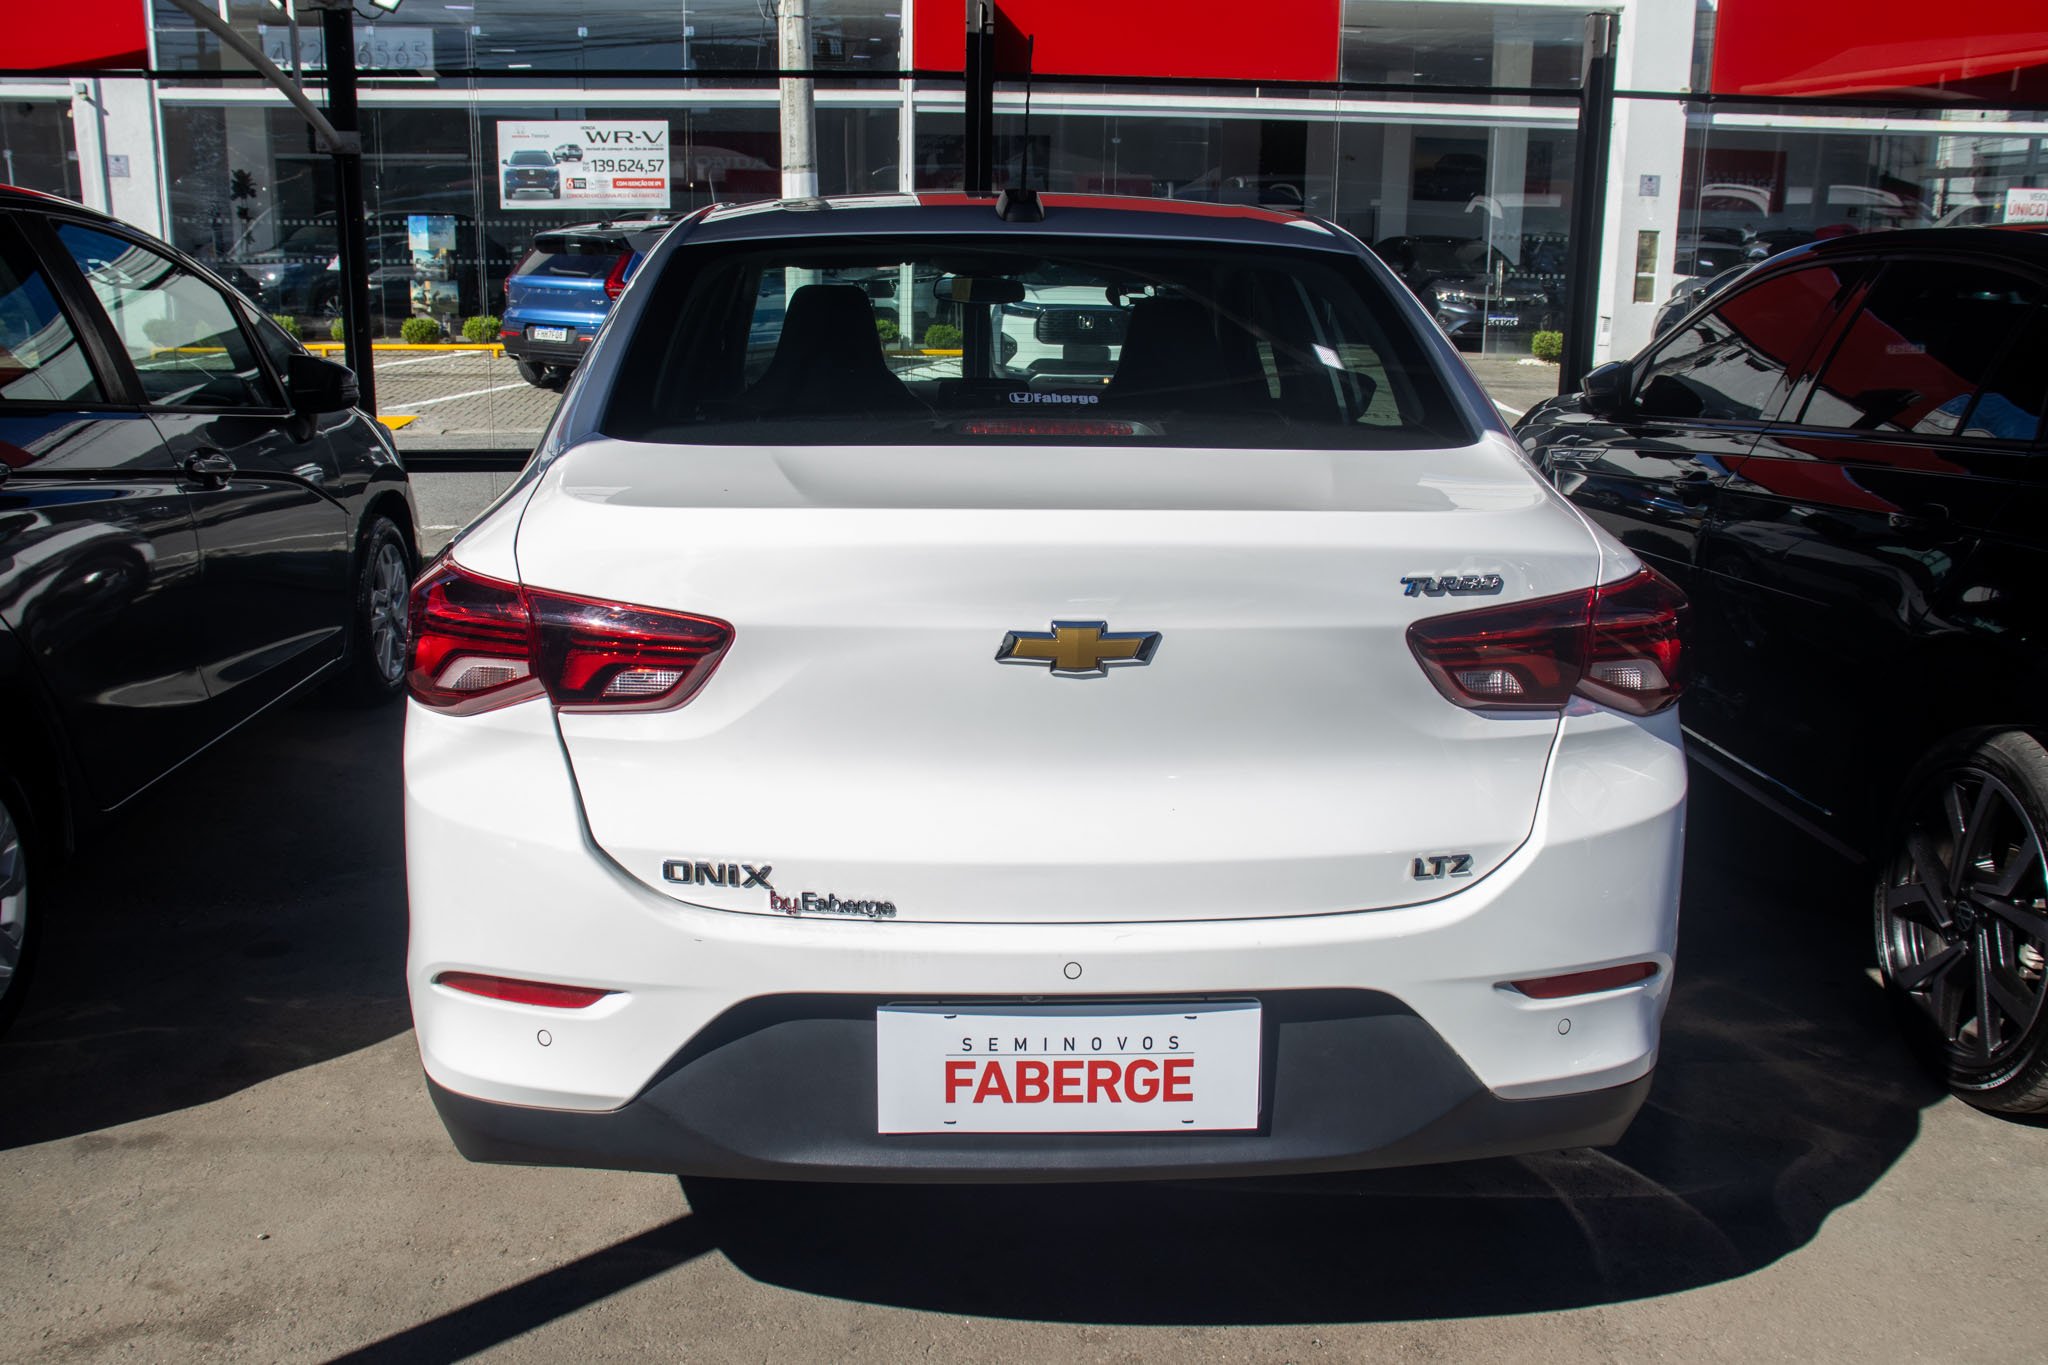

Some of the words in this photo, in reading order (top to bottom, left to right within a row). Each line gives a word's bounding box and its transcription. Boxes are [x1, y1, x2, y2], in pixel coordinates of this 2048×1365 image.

[585, 131, 664, 143] WR-V
[591, 159, 665, 174] 139.624,57
[1033, 393, 1099, 405] Faberge
[1400, 574, 1504, 597] TURBO
[662, 859, 774, 889] ONIX
[1410, 853, 1474, 881] LTZ
[962, 1036, 1179, 1052] SEMINOVOS
[945, 1058, 1195, 1104] FABERGE
